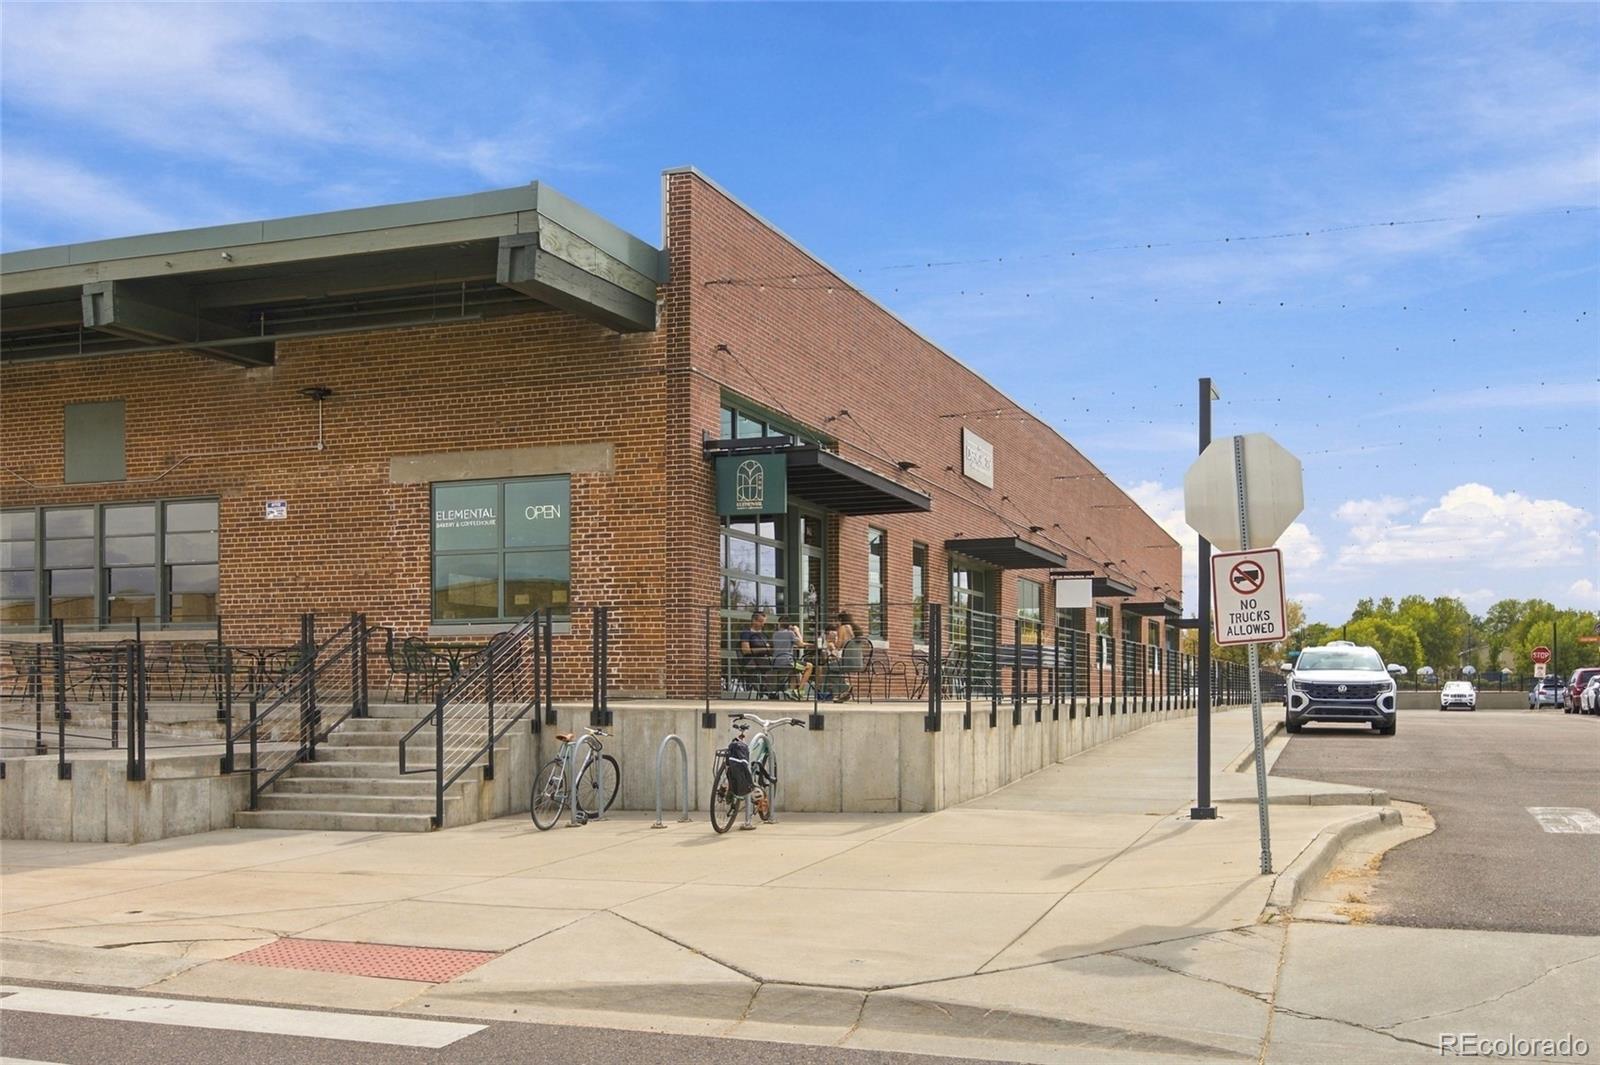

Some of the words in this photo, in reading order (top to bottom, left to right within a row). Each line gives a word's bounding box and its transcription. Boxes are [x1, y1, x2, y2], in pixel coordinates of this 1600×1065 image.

[436, 507, 497, 521] ELEMENTAL
[525, 504, 561, 520] OPEN
[1240, 598, 1257, 610] NO
[1229, 610, 1271, 624] TRUCKS
[1226, 622, 1275, 636] ALLOWED
[1533, 651, 1550, 659] STOP
